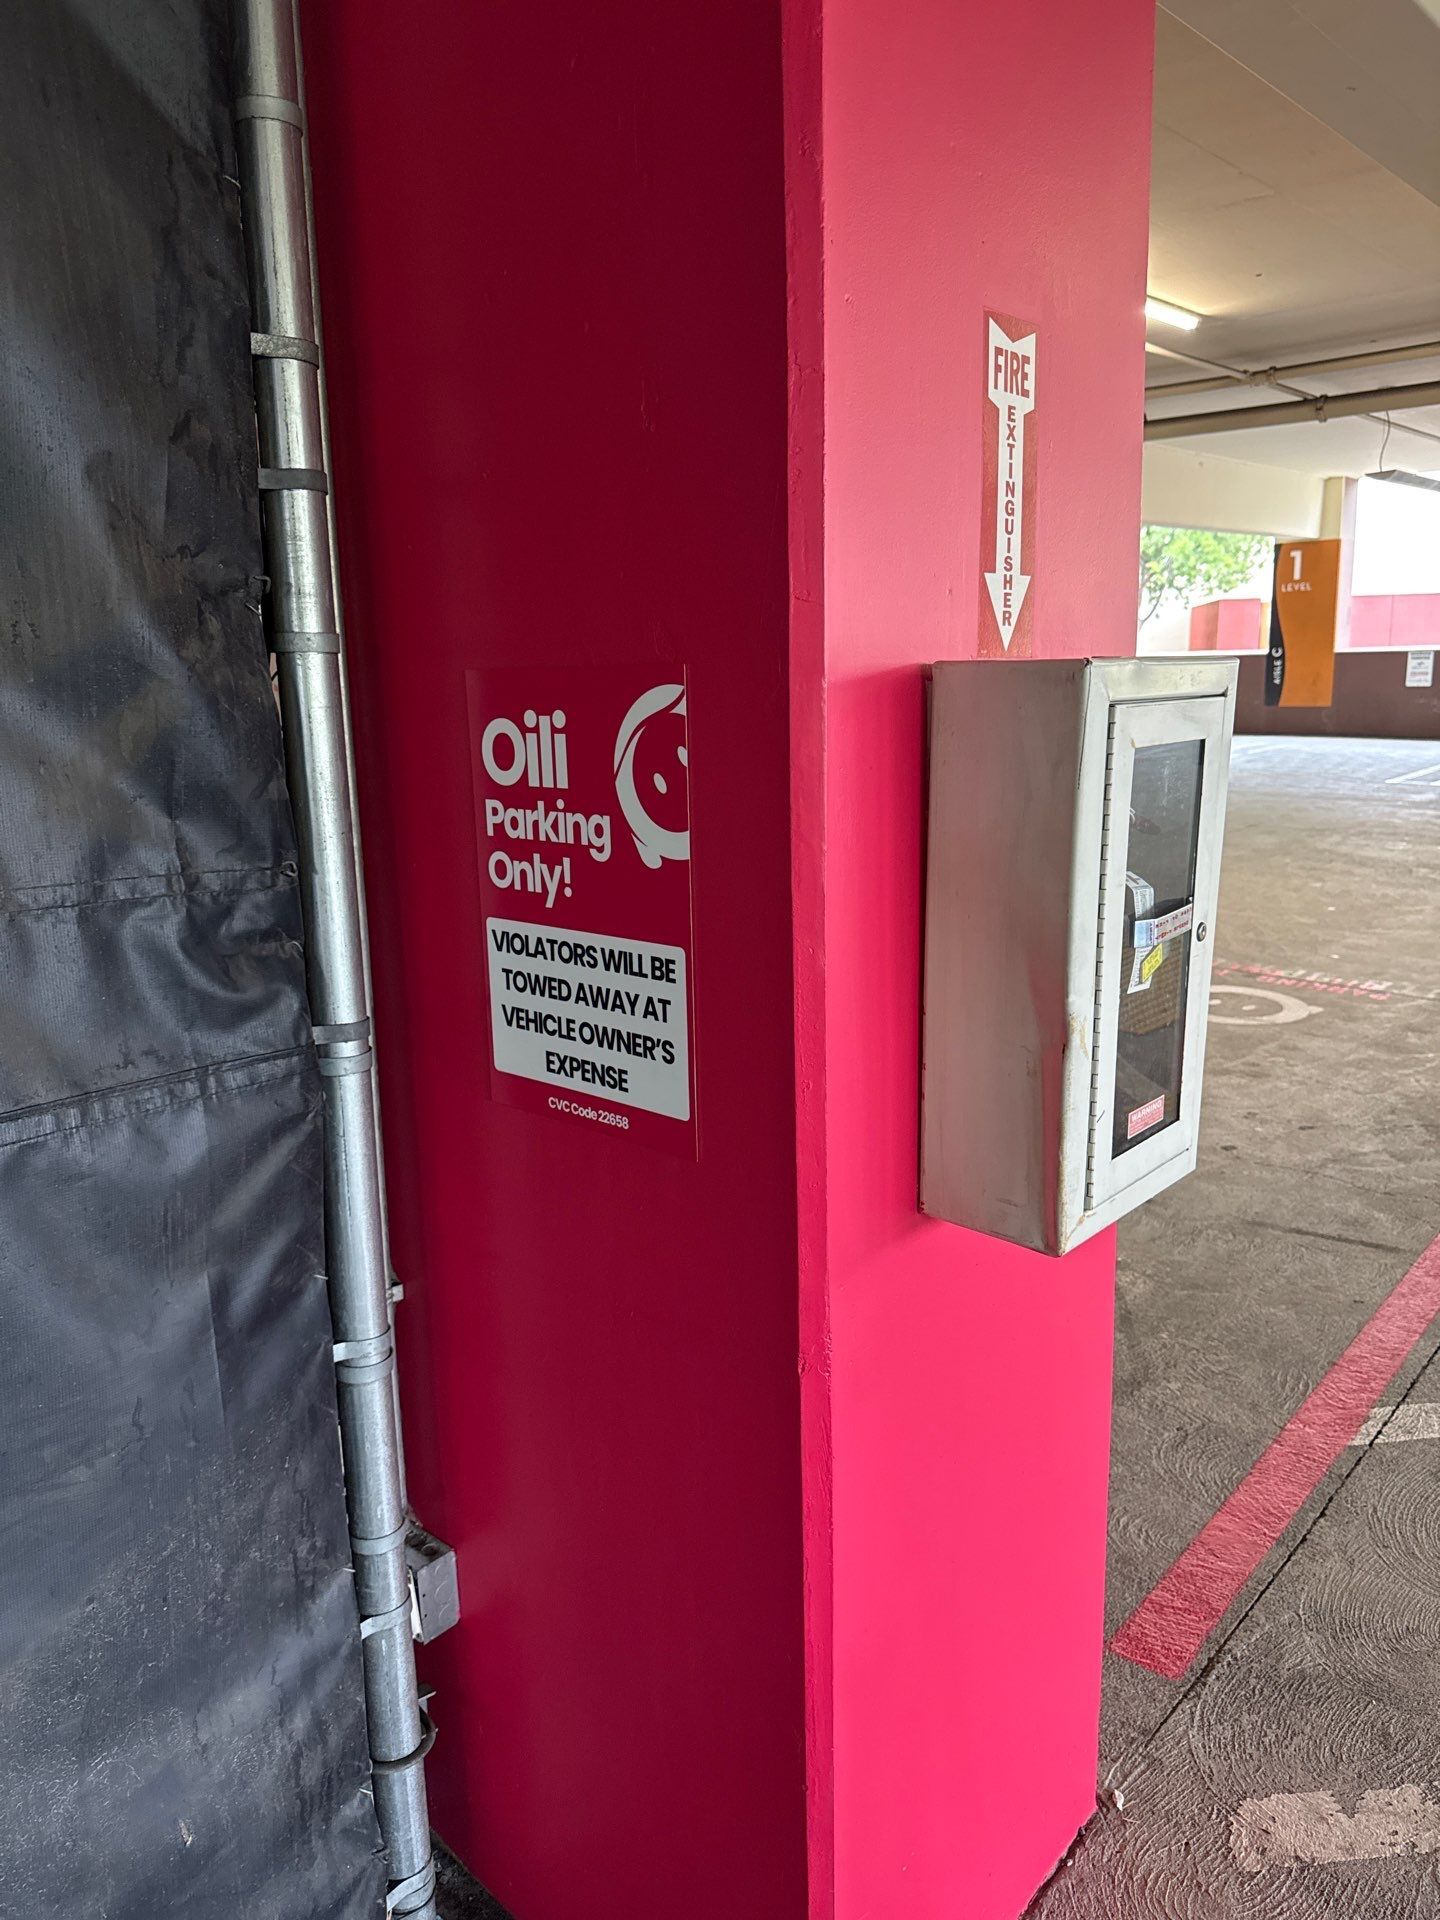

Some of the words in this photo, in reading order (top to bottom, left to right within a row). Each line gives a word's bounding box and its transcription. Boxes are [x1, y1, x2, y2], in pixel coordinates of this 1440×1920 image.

[994, 346, 1031, 399] FIRE
[1002, 405, 1017, 626] EXTINGUISHER
[1281, 581, 1312, 593] LEVEL
[1290, 550, 1303, 581] 1
[1271, 646, 1283, 657] C
[481, 709, 569, 789] Oili
[485, 798, 612, 863] Parking
[488, 851, 573, 909] Only!
[491, 929, 599, 969] VIOLATORS
[600, 947, 649, 979] WILL
[650, 955, 677, 984] BE
[501, 967, 572, 1002] TOWED
[574, 982, 640, 1016] AWAY
[642, 996, 672, 1024] AT
[501, 1004, 577, 1042] VEHICLE
[578, 1021, 675, 1065] OWNER'S
[545, 1050, 629, 1093] EXPENSE
[548, 1097, 570, 1113] CVC
[571, 1102, 598, 1121] Code
[597, 1109, 630, 1130] 22658
